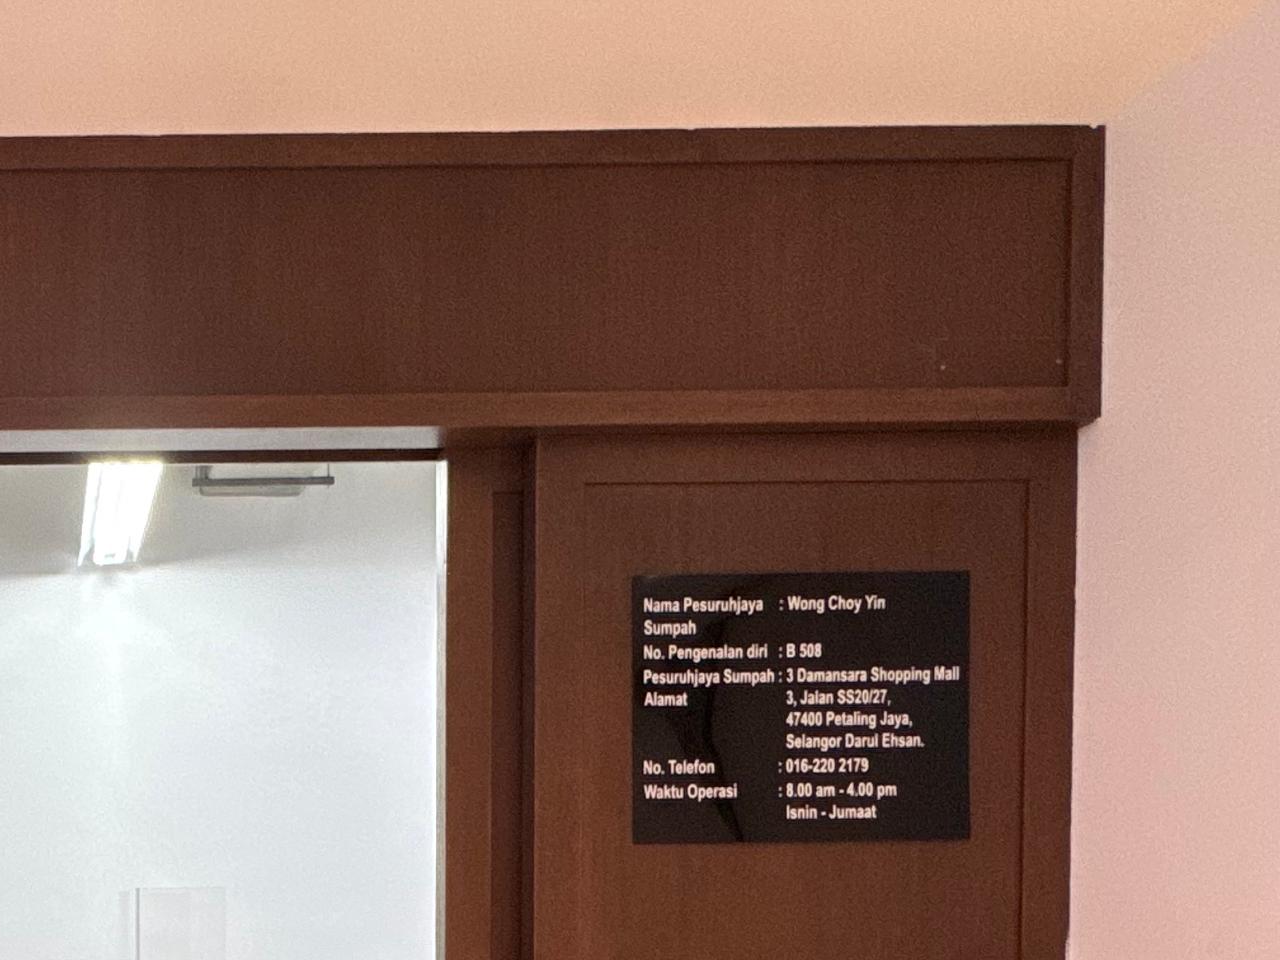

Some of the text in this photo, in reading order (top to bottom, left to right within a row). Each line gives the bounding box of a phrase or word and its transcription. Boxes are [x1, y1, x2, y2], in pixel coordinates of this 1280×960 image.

[643, 598, 680, 612] Nama
[683, 597, 763, 615] Pesuruhjaya
[787, 595, 825, 614] Wong
[828, 595, 862, 614] Choy
[865, 594, 886, 610] Yin
[644, 619, 697, 638] Sumpah
[643, 644, 665, 660] No.
[668, 644, 743, 663] Pengenalan
[746, 643, 768, 659] diri
[786, 643, 796, 658] B
[799, 643, 822, 658] 508
[643, 668, 720, 687] Pesuruhjaya
[723, 668, 775, 687] Sumpah
[786, 667, 794, 683] 3
[797, 667, 867, 682] Damansara
[870, 666, 931, 685] Shopping
[934, 665, 960, 681] Mall
[644, 691, 688, 706] Alamat
[786, 688, 891, 707] 3, Jalan SS20/27,
[786, 711, 913, 729] 47400 Petaling Jaya,
[786, 732, 925, 752] Selangor Darul Ehsan.
[643, 760, 665, 775] No.
[668, 759, 715, 774] Telefon
[785, 758, 835, 773] 016-220
[838, 757, 869, 773] 2179
[643, 784, 684, 799] Waktu
[687, 783, 738, 802] Operasi
[786, 783, 812, 798] 8.00
[815, 785, 836, 797] am
[846, 782, 873, 797] 4.00
[877, 784, 897, 800] pm
[786, 804, 818, 819] Isnin
[828, 804, 877, 819] Jumaat
